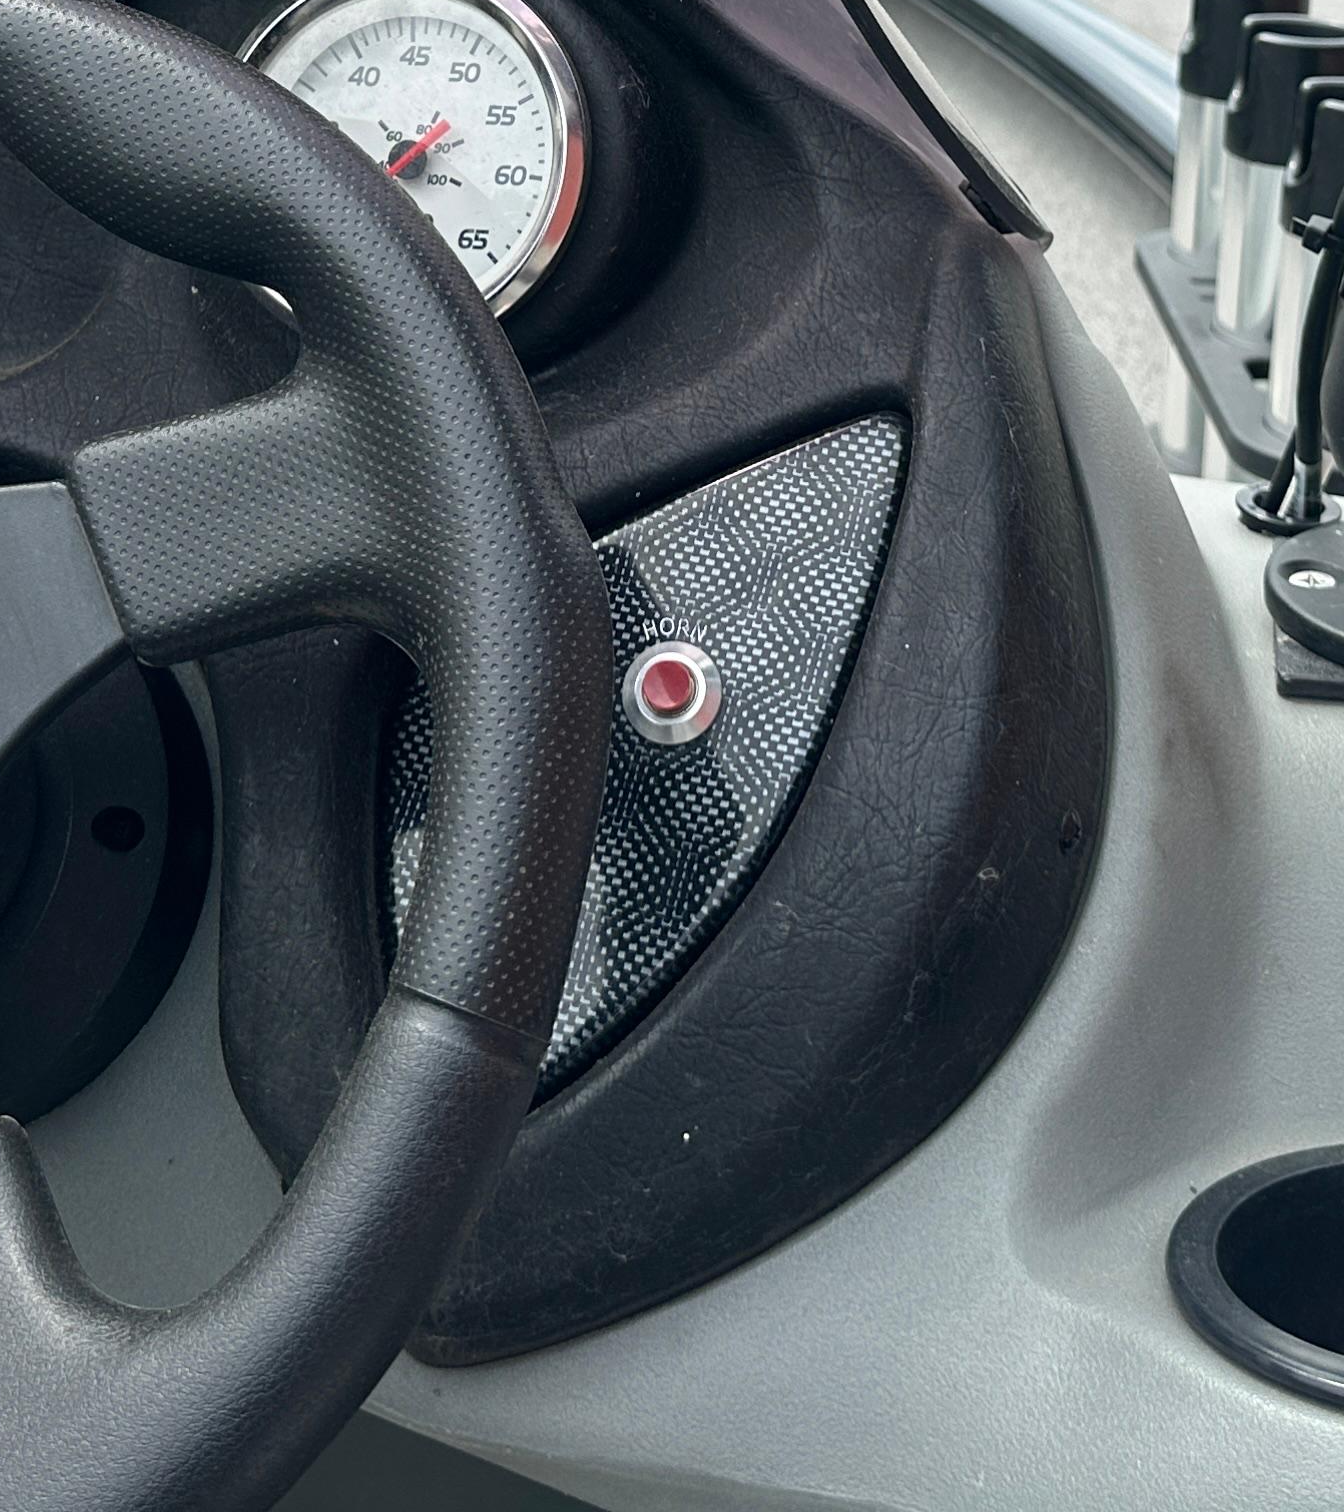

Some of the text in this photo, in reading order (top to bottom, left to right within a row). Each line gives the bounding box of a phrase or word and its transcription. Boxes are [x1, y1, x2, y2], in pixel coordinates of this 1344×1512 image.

[399, 46, 430, 66] 45
[348, 66, 380, 87] 40
[448, 63, 481, 83] 50
[485, 105, 517, 126] 55
[386, 130, 403, 142] 60
[433, 142, 451, 154] 90
[427, 174, 448, 186] 100
[494, 165, 527, 186] 60
[458, 229, 489, 249] 65
[642, 617, 707, 642] HORN
